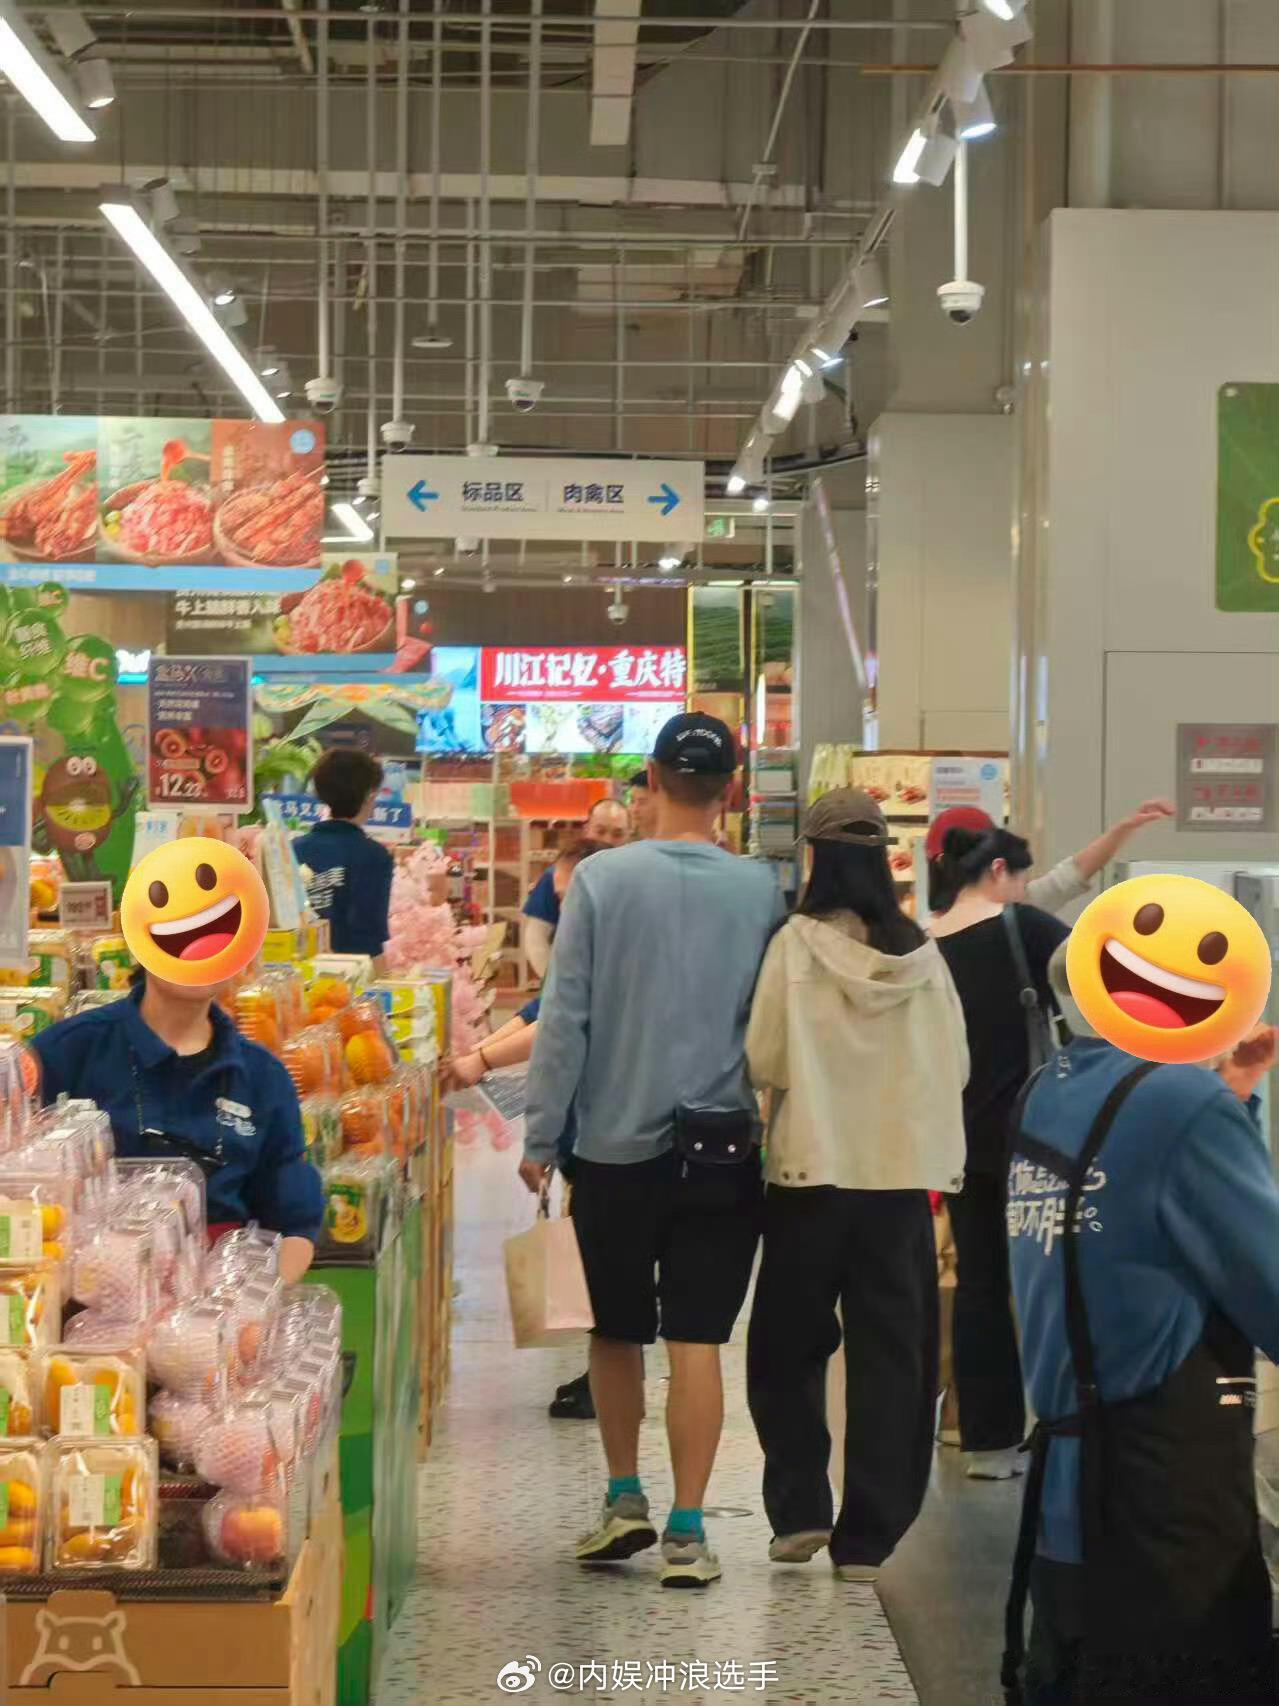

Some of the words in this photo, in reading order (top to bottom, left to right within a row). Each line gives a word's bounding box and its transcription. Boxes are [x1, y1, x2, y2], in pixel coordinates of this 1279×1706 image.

[461, 481, 525, 502] 标品区
[563, 483, 625, 504] 肉禽区
[495, 648, 687, 689] 川江记忆·重庆特
